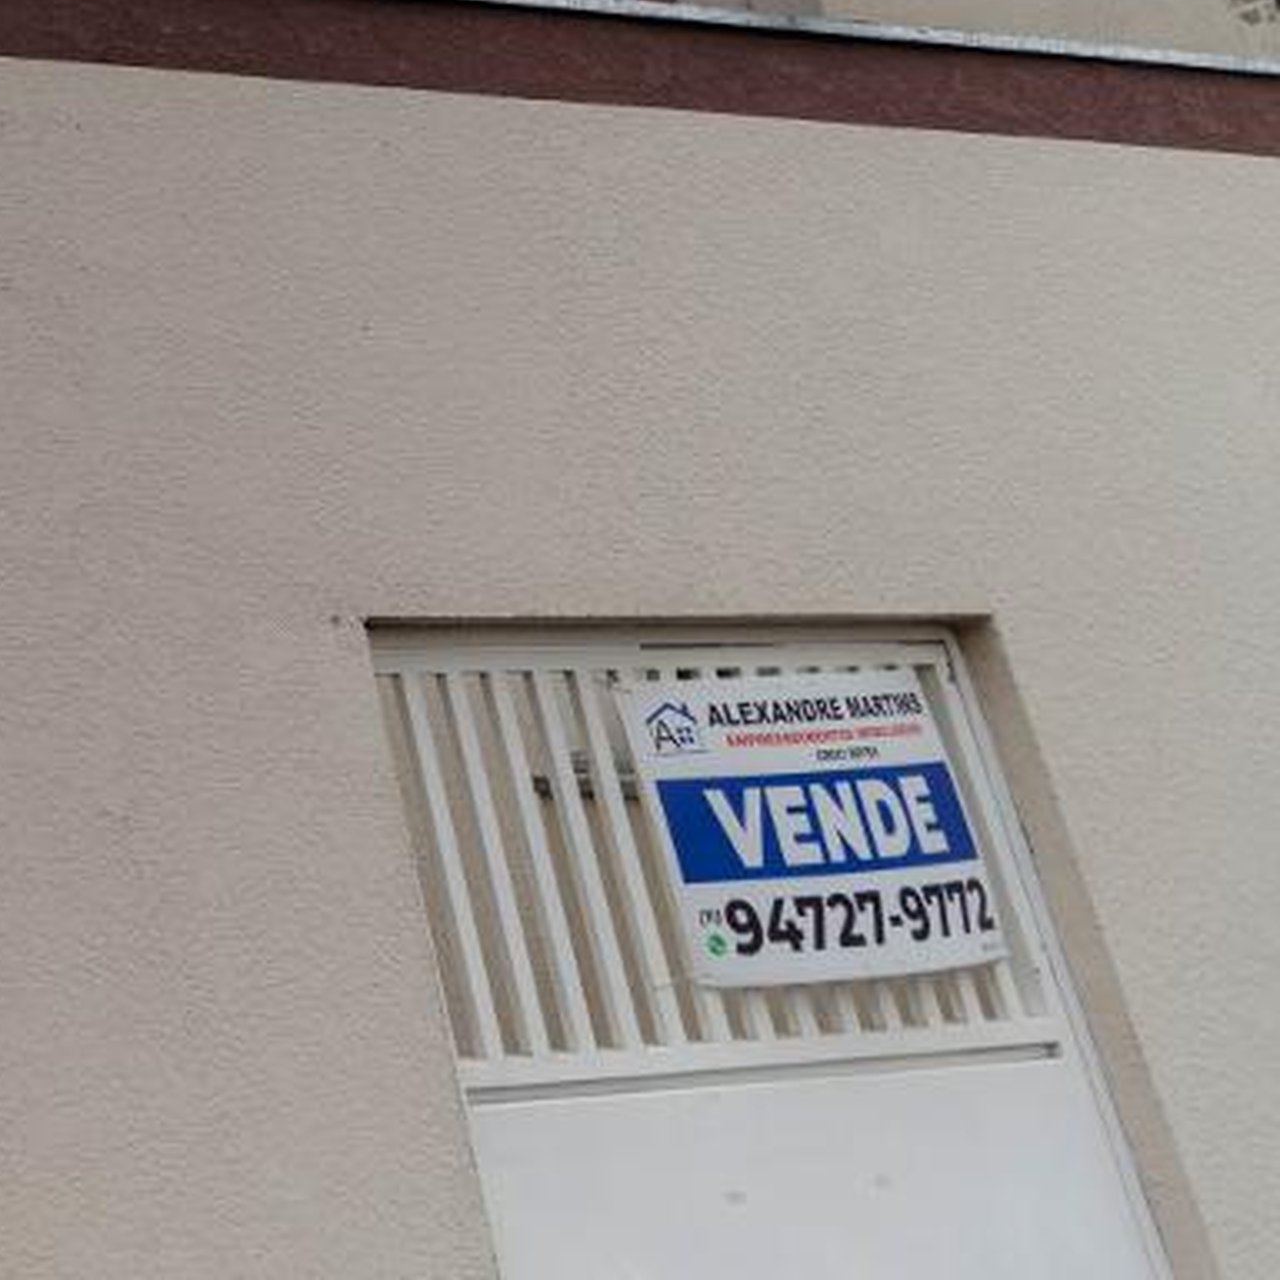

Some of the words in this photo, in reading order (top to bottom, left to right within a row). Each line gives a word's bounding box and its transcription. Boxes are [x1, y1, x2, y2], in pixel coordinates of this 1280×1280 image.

[707, 696, 845, 727] ALEXANDRE
[703, 775, 949, 868] VENDE
[724, 877, 994, 956] 94727-9772
